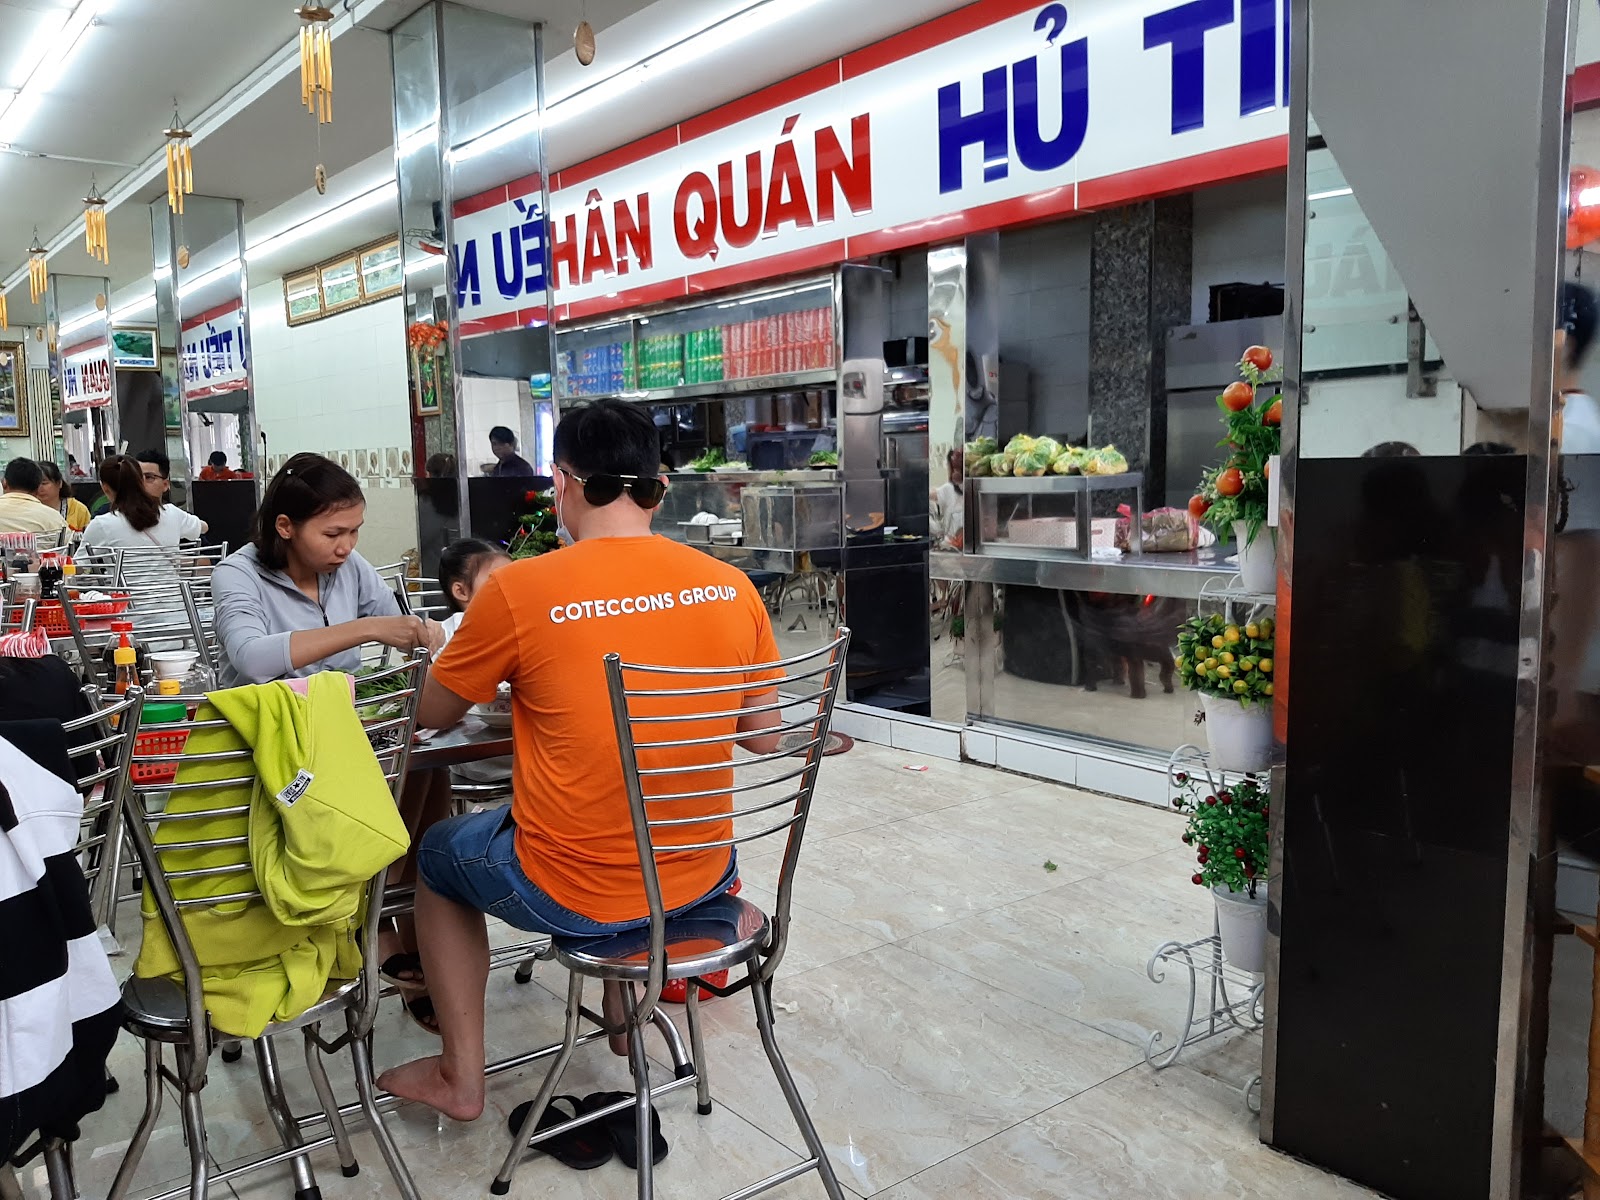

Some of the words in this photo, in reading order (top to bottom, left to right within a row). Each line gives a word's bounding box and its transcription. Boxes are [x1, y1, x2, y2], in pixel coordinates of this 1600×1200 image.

[673, 111, 873, 263] QUÁN
[938, 4, 1089, 194] HỦ
[1143, 0, 1291, 136] TI
[549, 592, 675, 624] COTECCONS
[678, 585, 737, 606] GROUP
